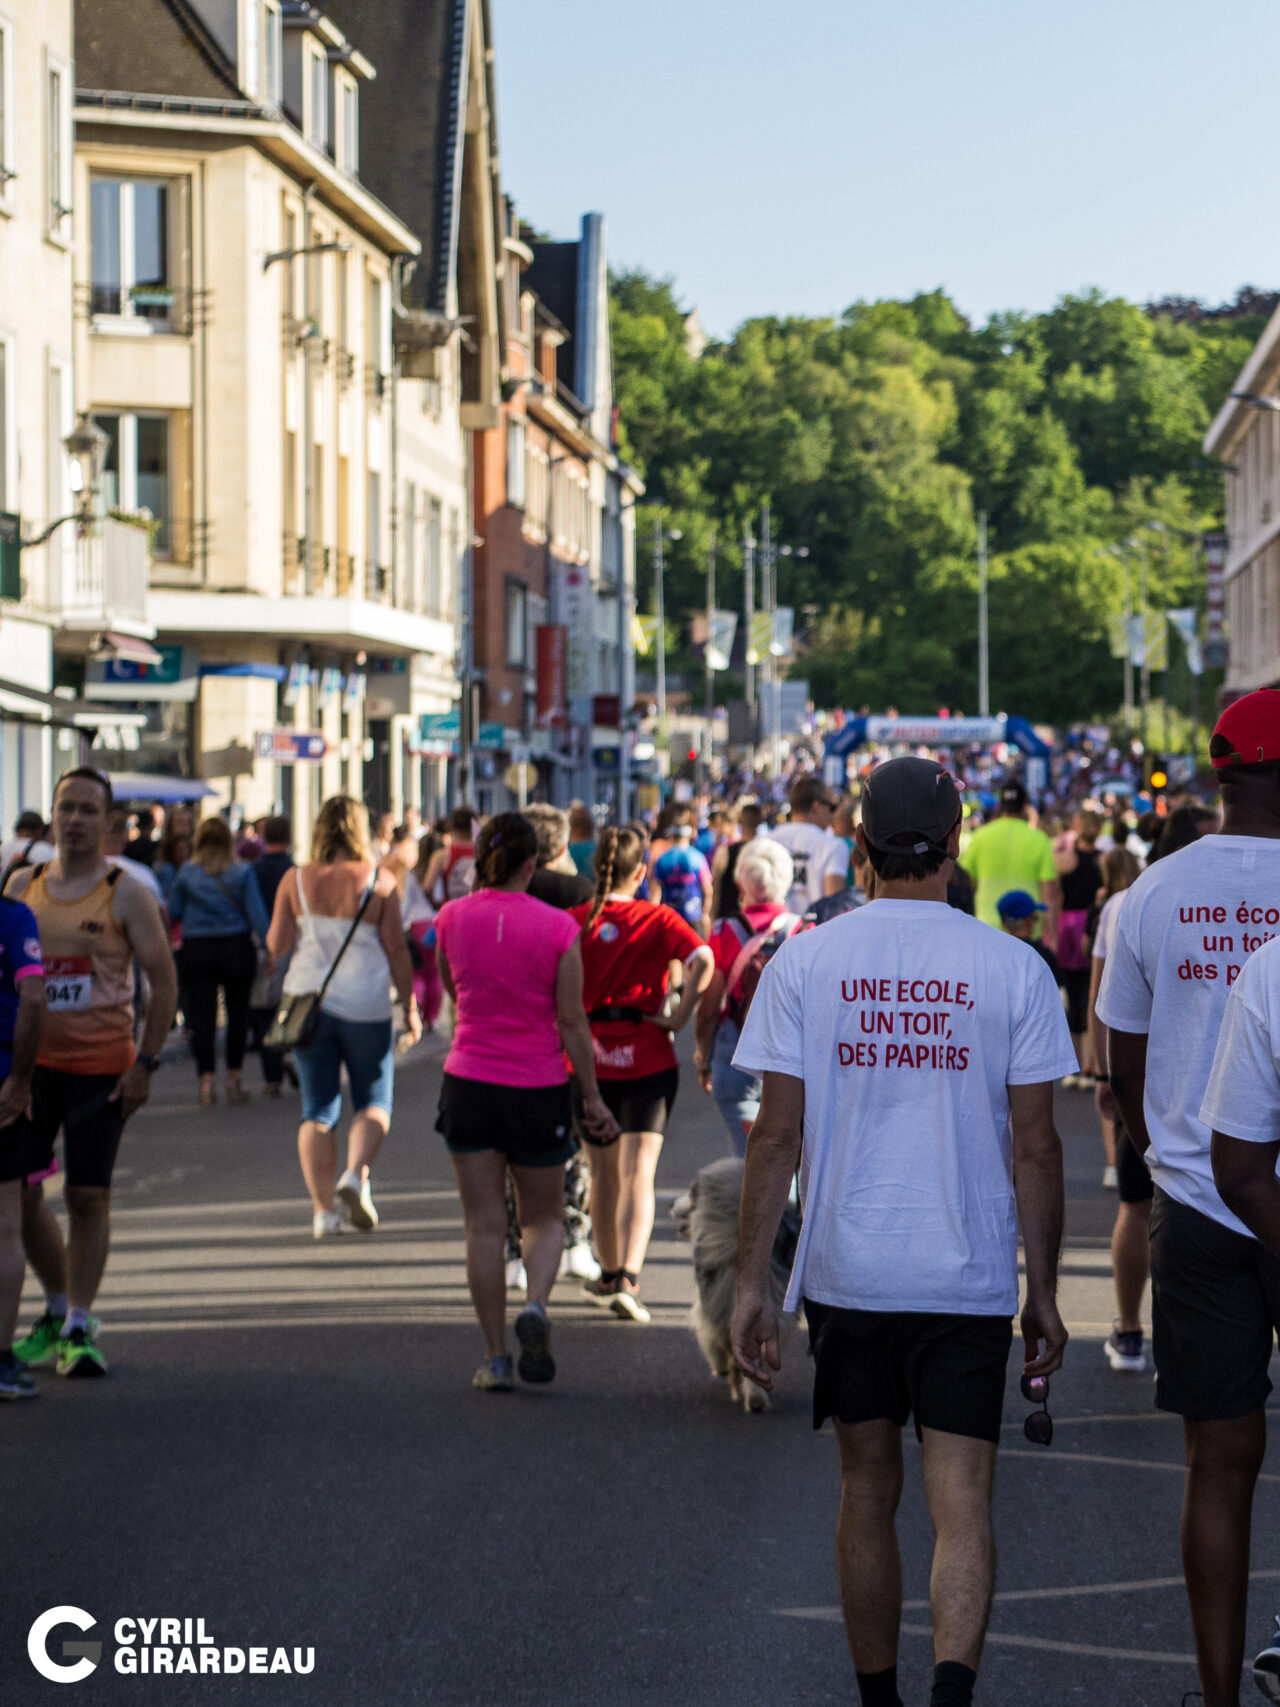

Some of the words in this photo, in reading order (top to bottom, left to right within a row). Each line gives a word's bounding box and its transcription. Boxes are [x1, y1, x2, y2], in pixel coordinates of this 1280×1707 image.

[1179, 906, 1227, 924] une
[1203, 935, 1234, 952] un
[1177, 959, 1219, 981] des
[841, 978, 891, 1003] UNE
[897, 980, 975, 1011] ECOLE,
[860, 1010, 894, 1035] UN
[899, 1011, 953, 1040] TOIT,
[838, 1042, 878, 1068] DES
[885, 1043, 970, 1071] PAPIERS
